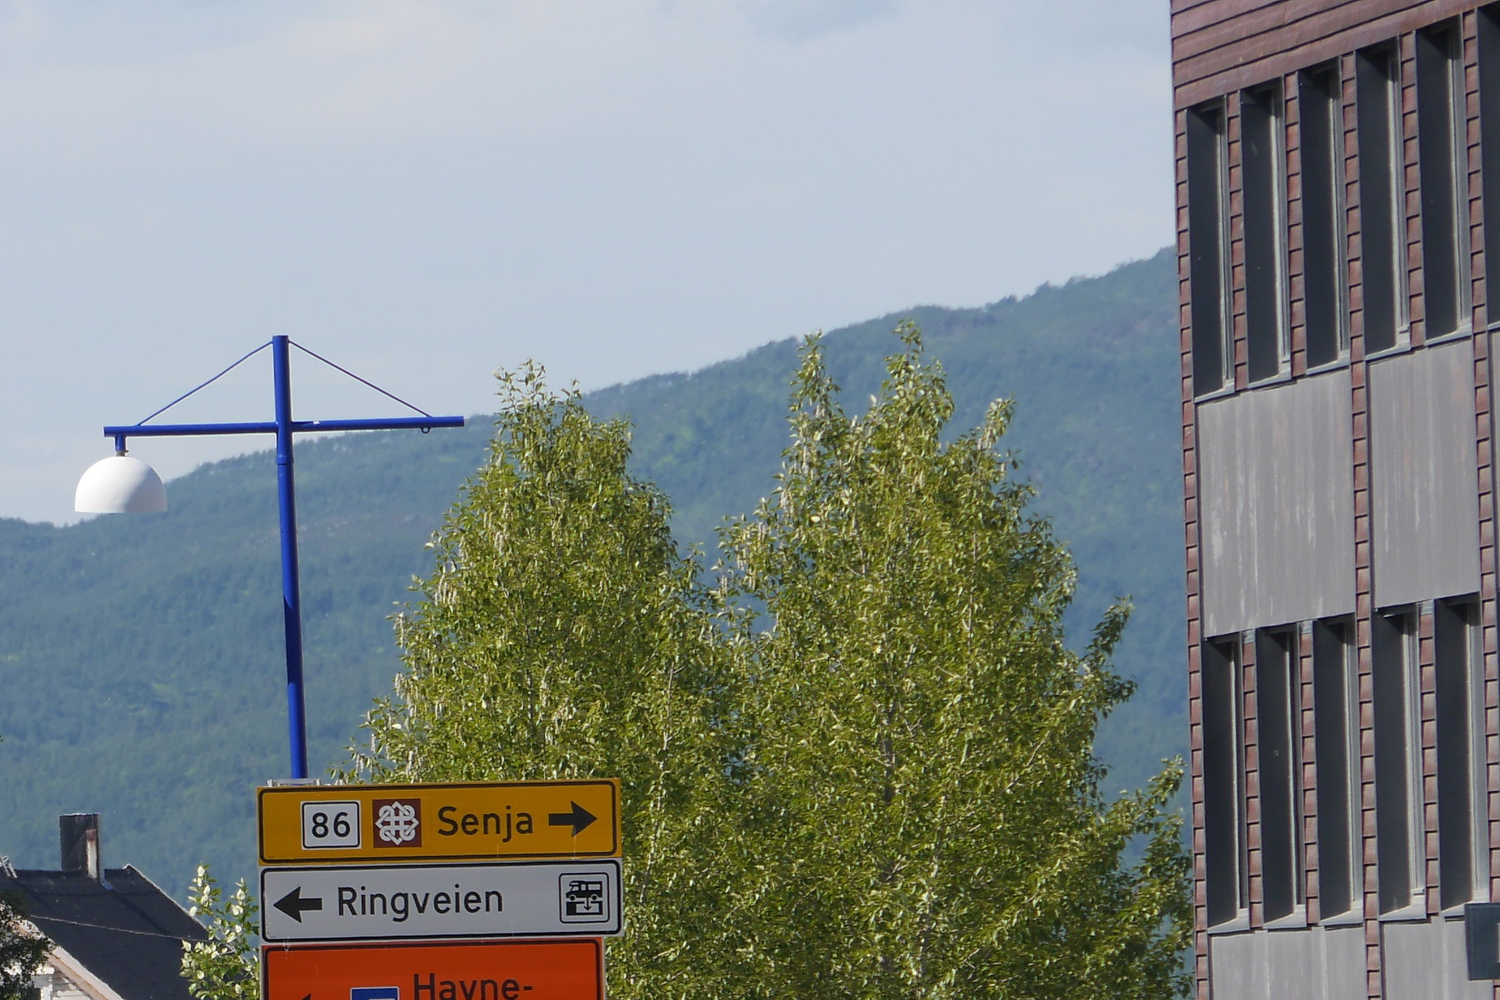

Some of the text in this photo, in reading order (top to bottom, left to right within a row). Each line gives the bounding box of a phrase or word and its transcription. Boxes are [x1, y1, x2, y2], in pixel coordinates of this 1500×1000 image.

[312, 805, 533, 843] 86 Senja
[337, 883, 503, 922] Ringveien
